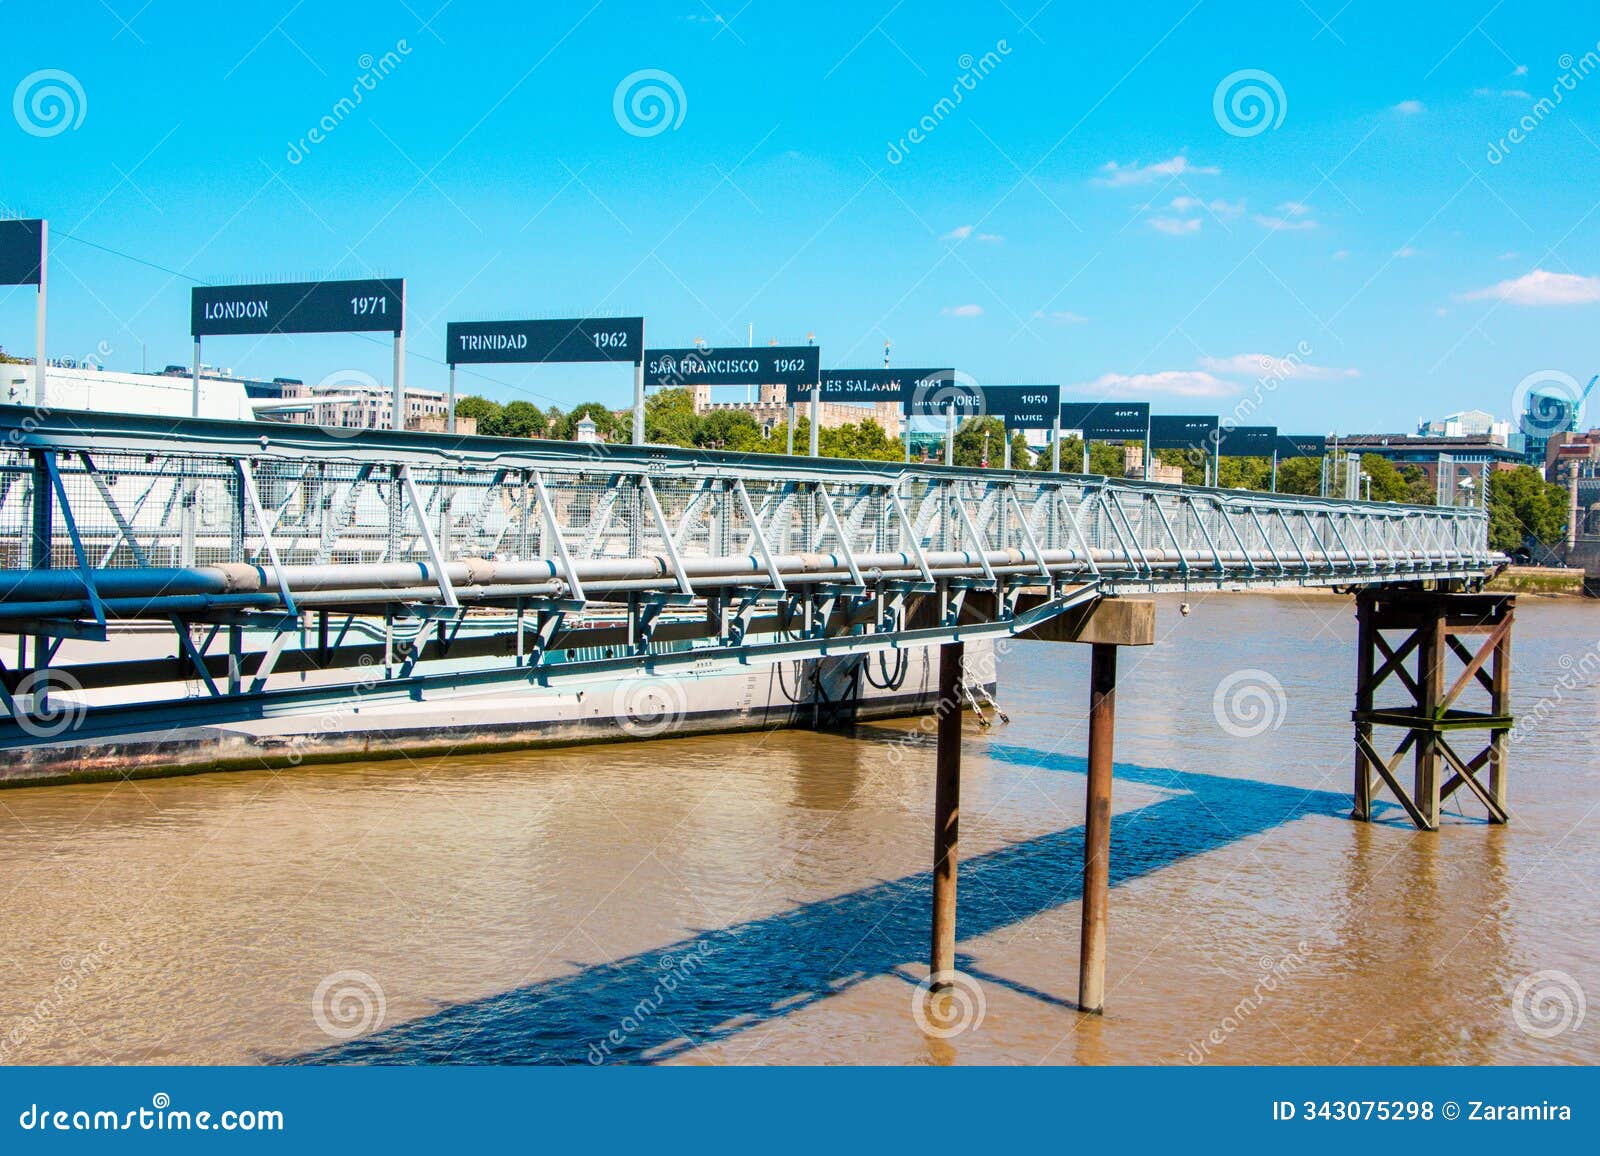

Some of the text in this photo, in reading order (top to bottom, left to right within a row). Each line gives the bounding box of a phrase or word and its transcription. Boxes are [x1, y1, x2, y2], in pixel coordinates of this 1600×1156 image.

[205, 296, 387, 319] LONDON 1971
[460, 332, 627, 350] TRINIDAD 1962
[649, 358, 805, 374] SAN FRANCISCO 1962
[826, 379, 842, 392] ES
[846, 379, 901, 392] SALAAM
